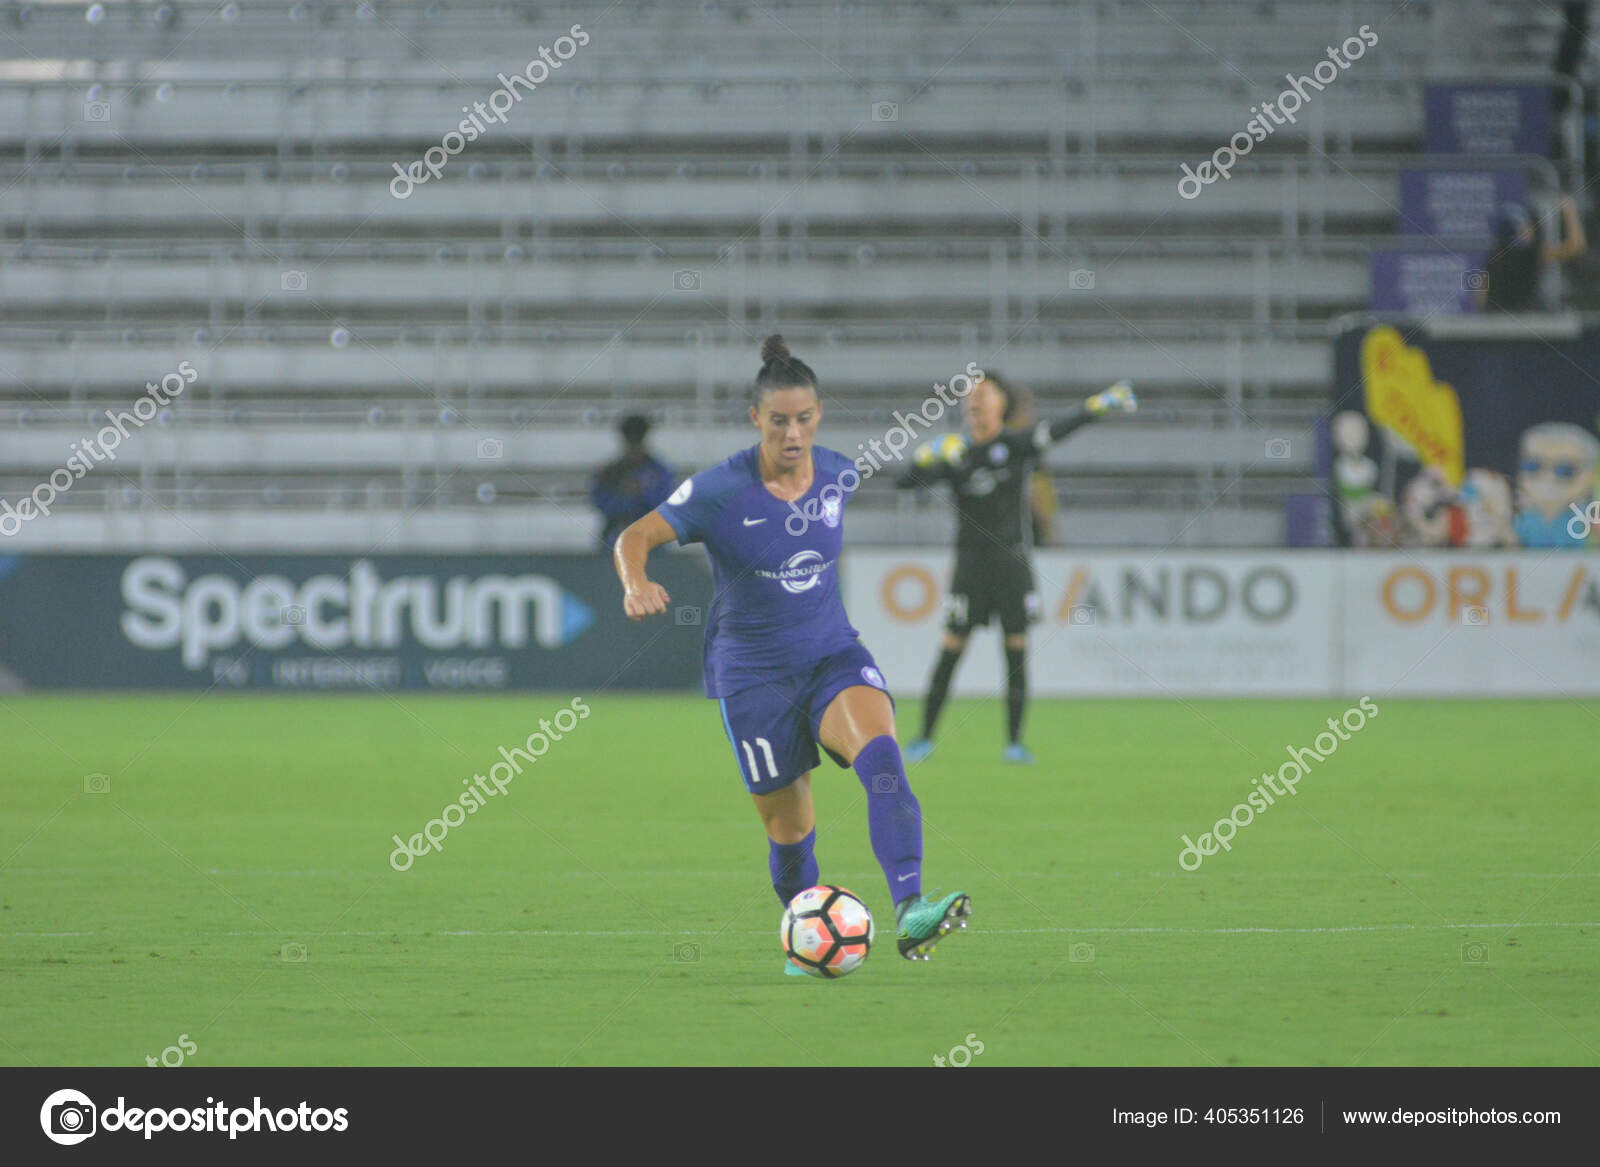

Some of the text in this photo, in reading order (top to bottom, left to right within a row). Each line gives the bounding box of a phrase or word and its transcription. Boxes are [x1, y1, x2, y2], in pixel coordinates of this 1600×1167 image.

[121, 556, 565, 670] Spectrum
[880, 564, 1297, 623] OANDO
[741, 737, 779, 783] 11
